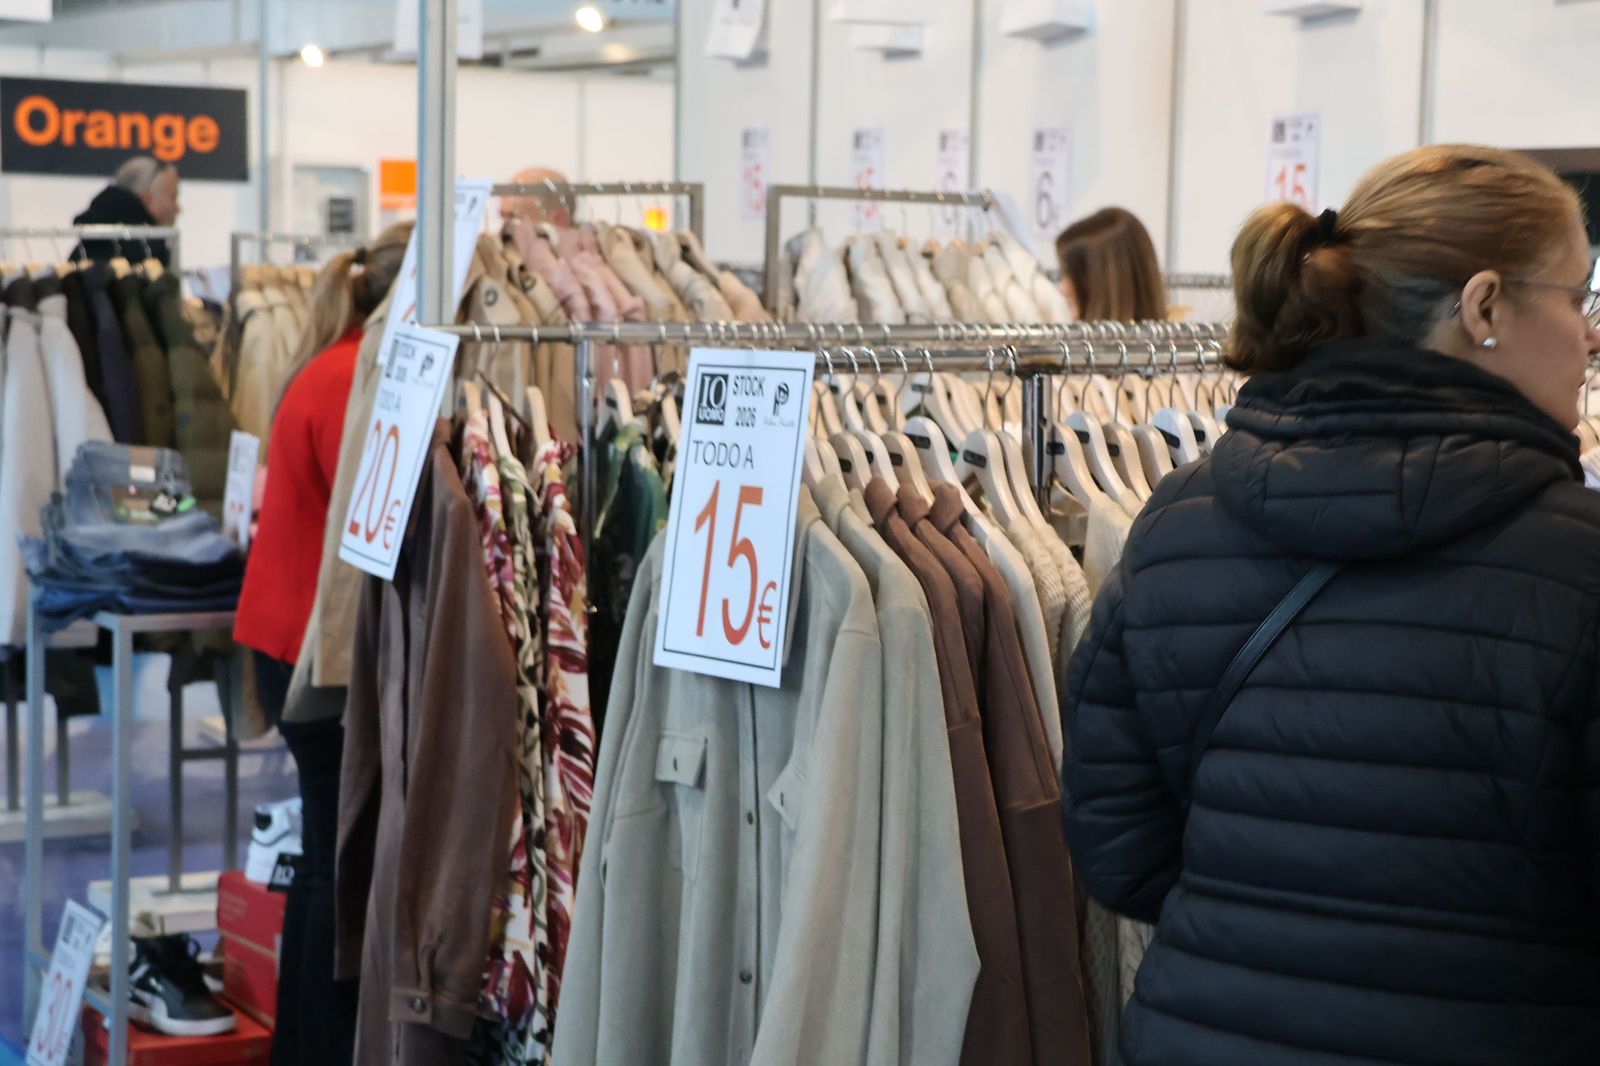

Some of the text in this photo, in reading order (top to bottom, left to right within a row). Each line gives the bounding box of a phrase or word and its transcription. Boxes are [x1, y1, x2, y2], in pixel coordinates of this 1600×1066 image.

[14, 94, 220, 163] Orange
[732, 375, 764, 397] STOCK
[692, 439, 754, 469] TODO A
[694, 479, 776, 650] 15€
